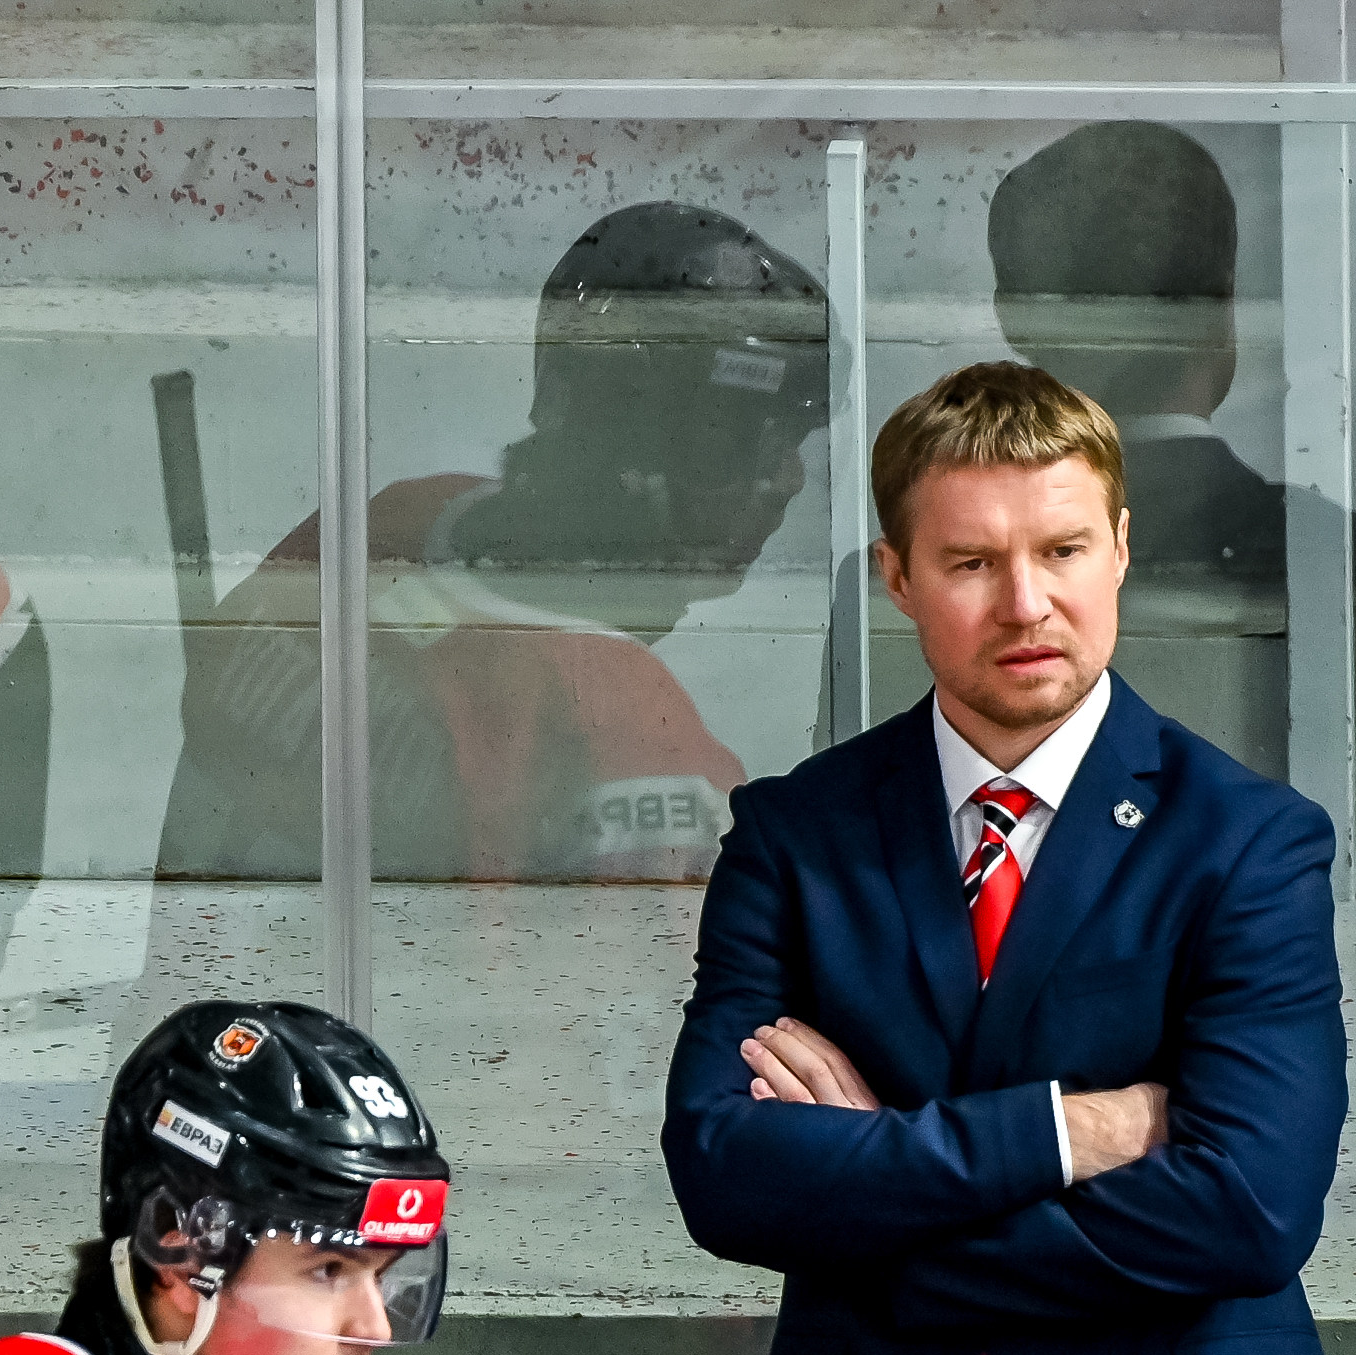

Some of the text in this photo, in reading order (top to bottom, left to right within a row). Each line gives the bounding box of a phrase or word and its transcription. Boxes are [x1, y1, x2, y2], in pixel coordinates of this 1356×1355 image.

[348, 1075, 409, 1119] 93
[169, 1116, 224, 1155] ЕВРАЗ
[363, 1220, 435, 1237] OLIMPBET
